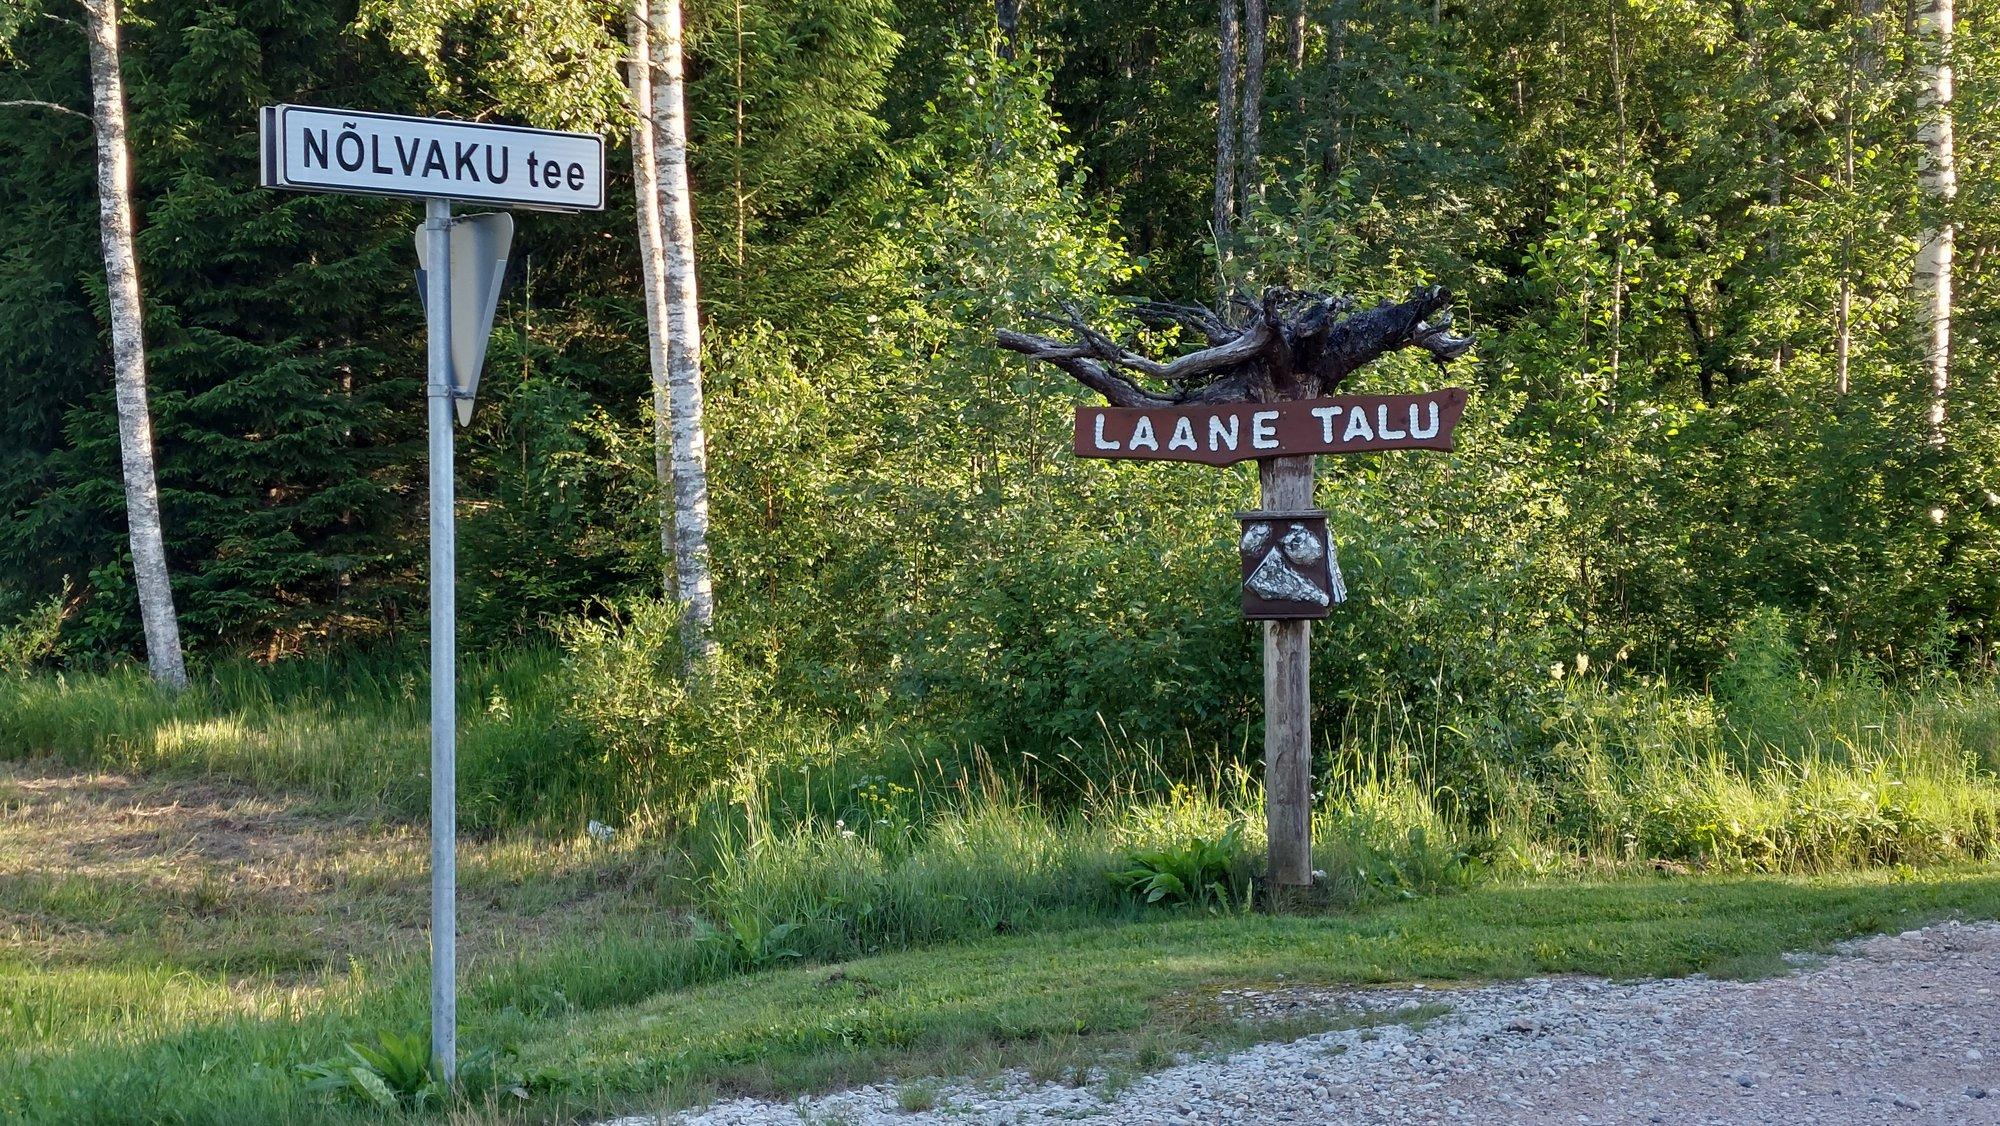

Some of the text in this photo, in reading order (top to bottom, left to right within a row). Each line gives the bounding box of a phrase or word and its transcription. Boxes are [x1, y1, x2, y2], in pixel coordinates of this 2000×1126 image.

[303, 121, 586, 191] NÕLVAKU tee
[1094, 400, 1440, 452] LAANE TALU
